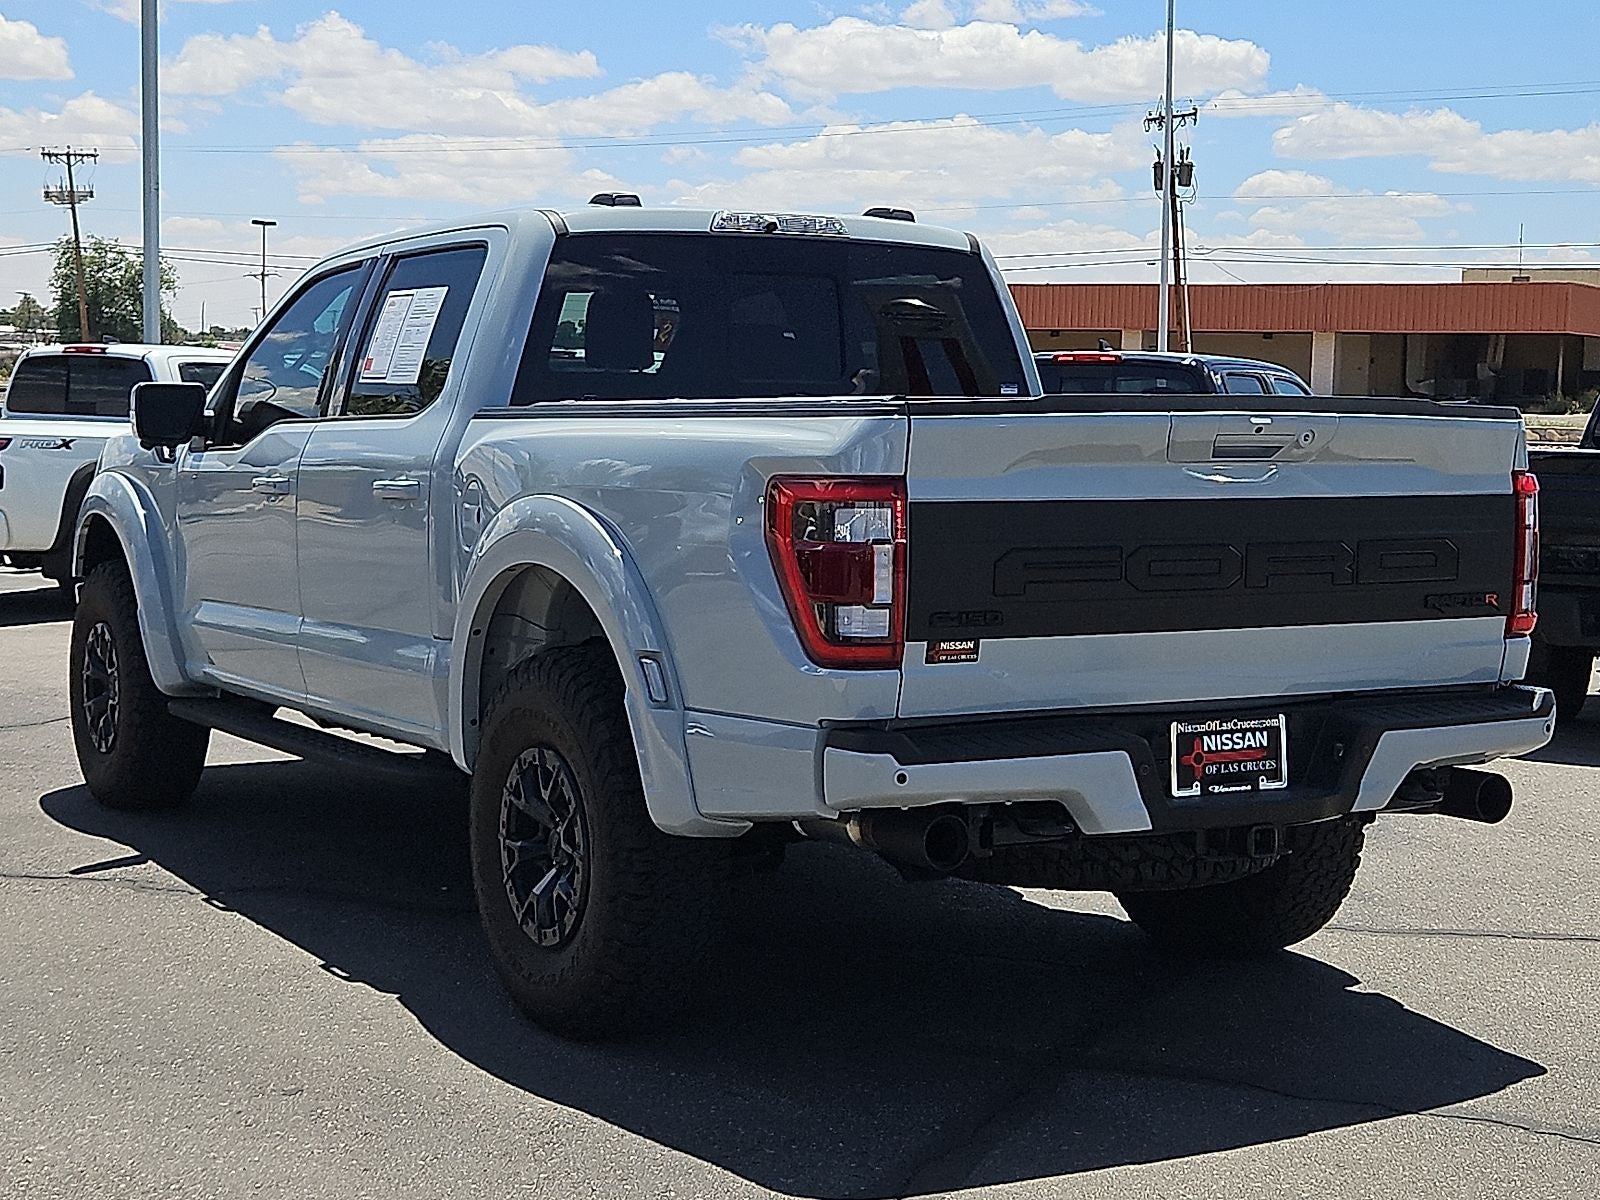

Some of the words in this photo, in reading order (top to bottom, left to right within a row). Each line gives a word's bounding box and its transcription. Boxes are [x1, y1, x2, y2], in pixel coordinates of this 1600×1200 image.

[993, 537, 1459, 596] FORD
[940, 641, 974, 650] NISSAN
[1202, 731, 1268, 751] NISSAN
[1205, 764, 1220, 775] OF
[1220, 762, 1239, 774] LAS
[1240, 759, 1277, 772] CRUCES
